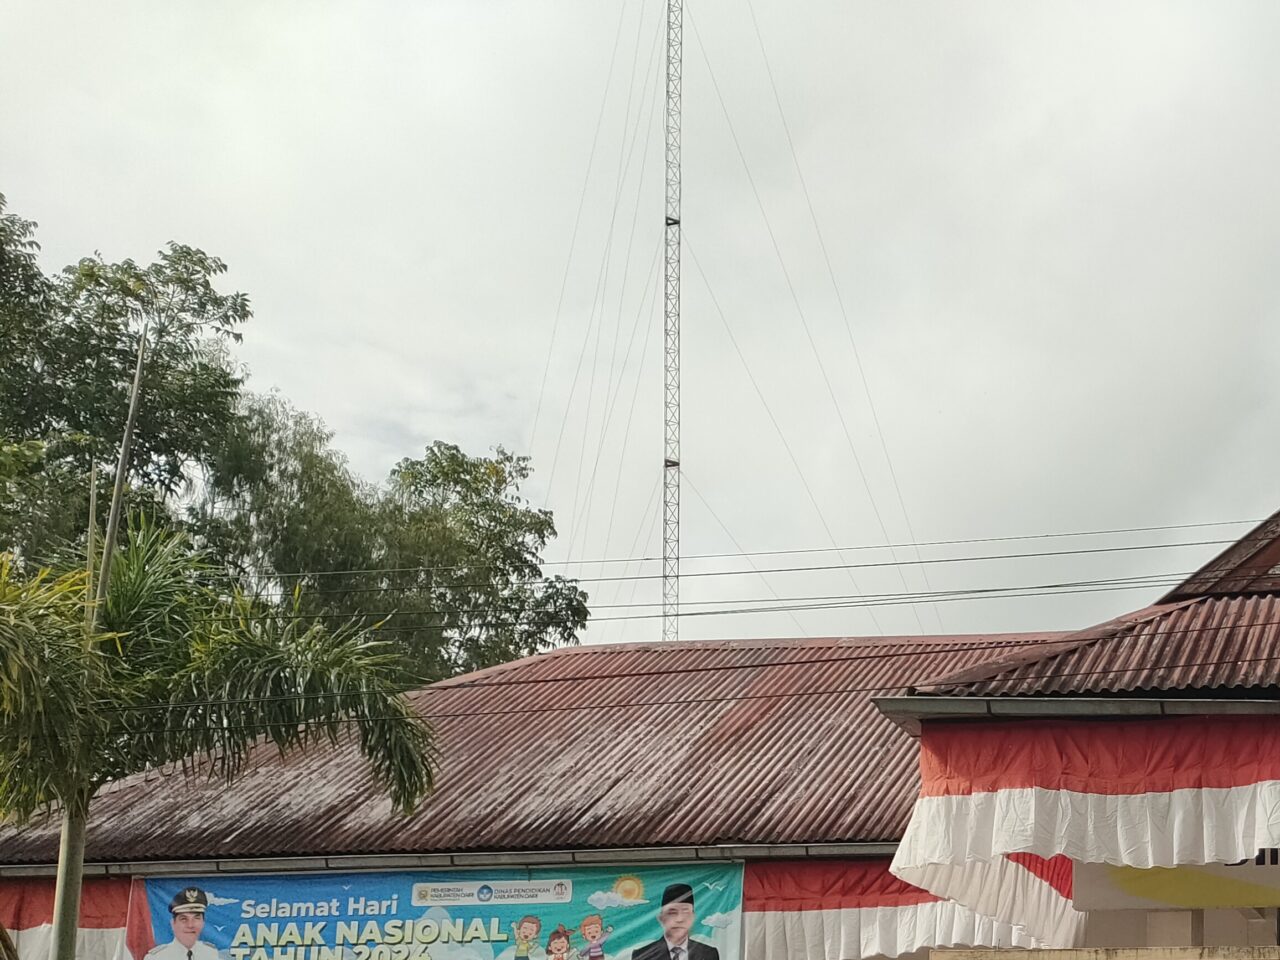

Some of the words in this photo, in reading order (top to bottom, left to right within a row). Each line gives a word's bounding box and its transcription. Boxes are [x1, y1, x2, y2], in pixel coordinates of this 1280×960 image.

[240, 898, 340, 918] Selamat
[347, 894, 399, 916] Hari
[231, 921, 327, 947] ANAK
[335, 917, 509, 946] NASIONAL
